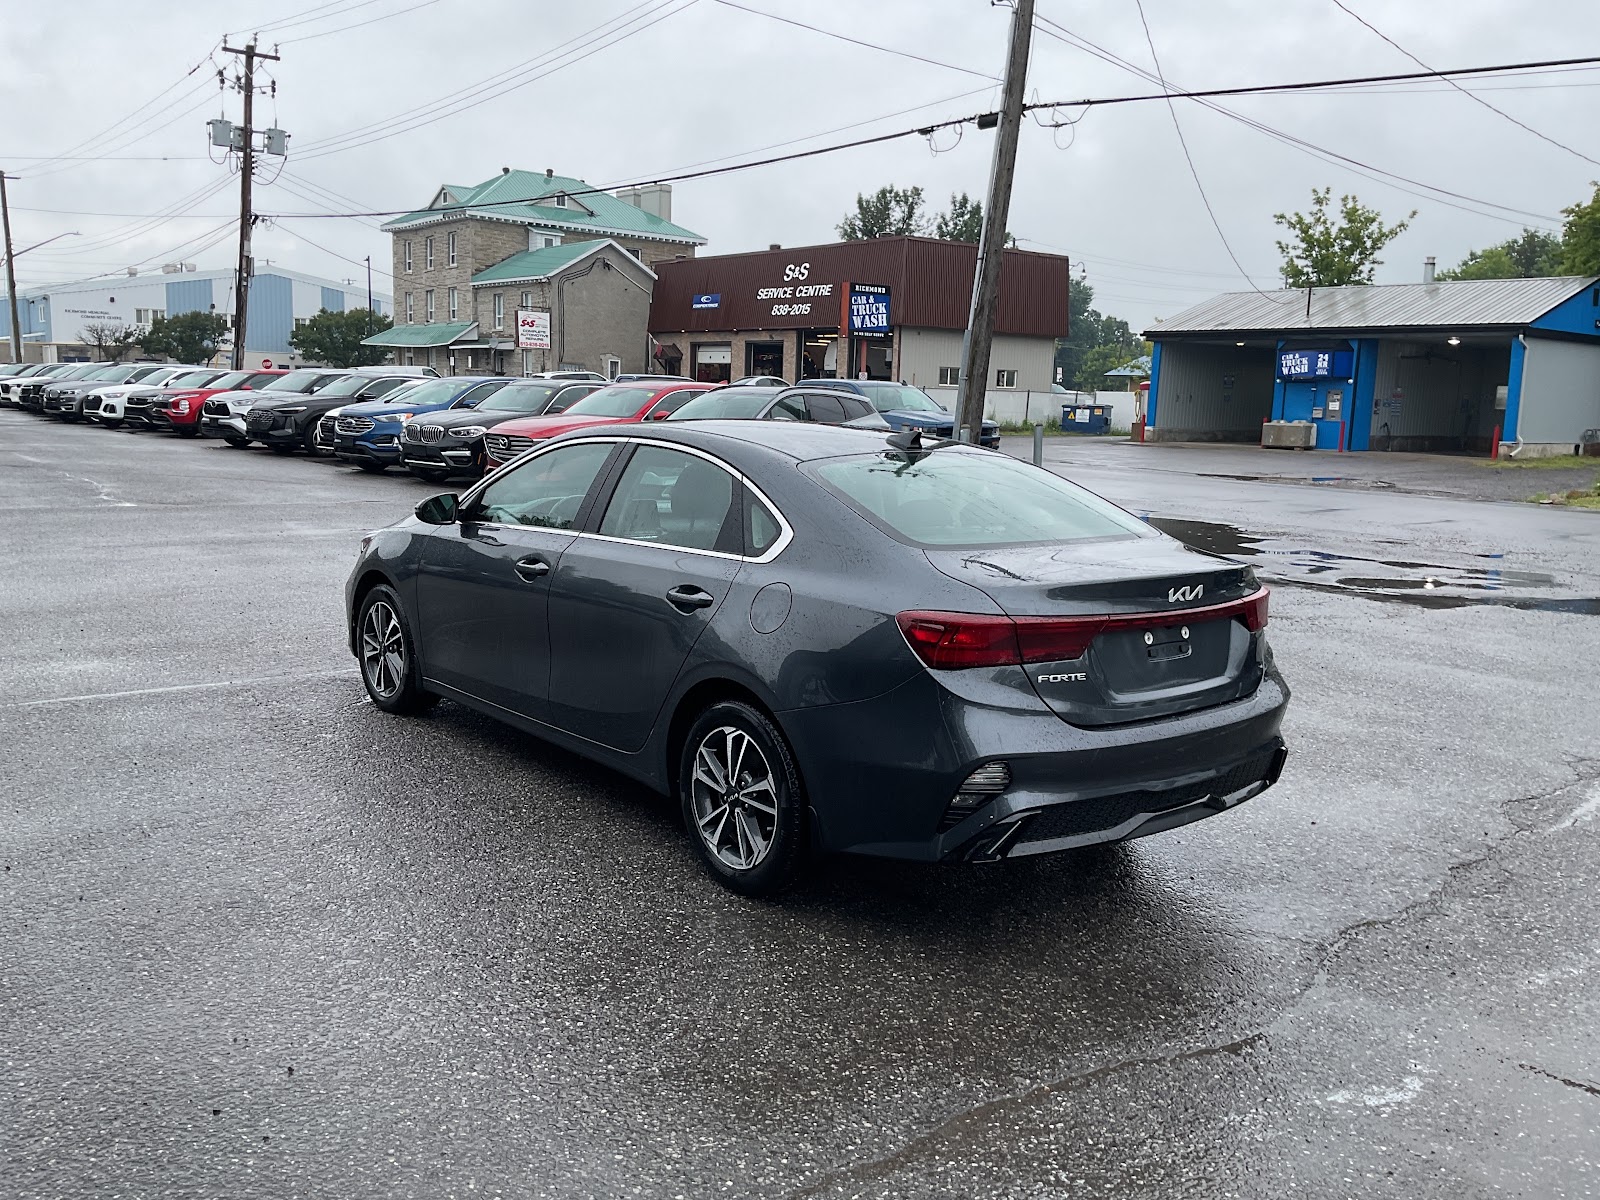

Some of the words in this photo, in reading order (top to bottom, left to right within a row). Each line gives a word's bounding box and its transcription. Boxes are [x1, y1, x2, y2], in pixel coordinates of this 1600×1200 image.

[783, 262, 810, 282] S&S
[756, 287, 794, 300] SERVICE
[795, 284, 833, 297] CENTRE
[855, 285, 886, 293] RICHMOND
[851, 295, 867, 305] CAR
[868, 295, 875, 304] &
[771, 304, 812, 316] 838-2015
[851, 303, 887, 316] TRUCK
[852, 314, 888, 328] WASH
[1281, 357, 1309, 368] TRUCK
[1318, 353, 1329, 362] 24
[1281, 364, 1309, 375] WASH
[1037, 672, 1087, 684] FORTE
